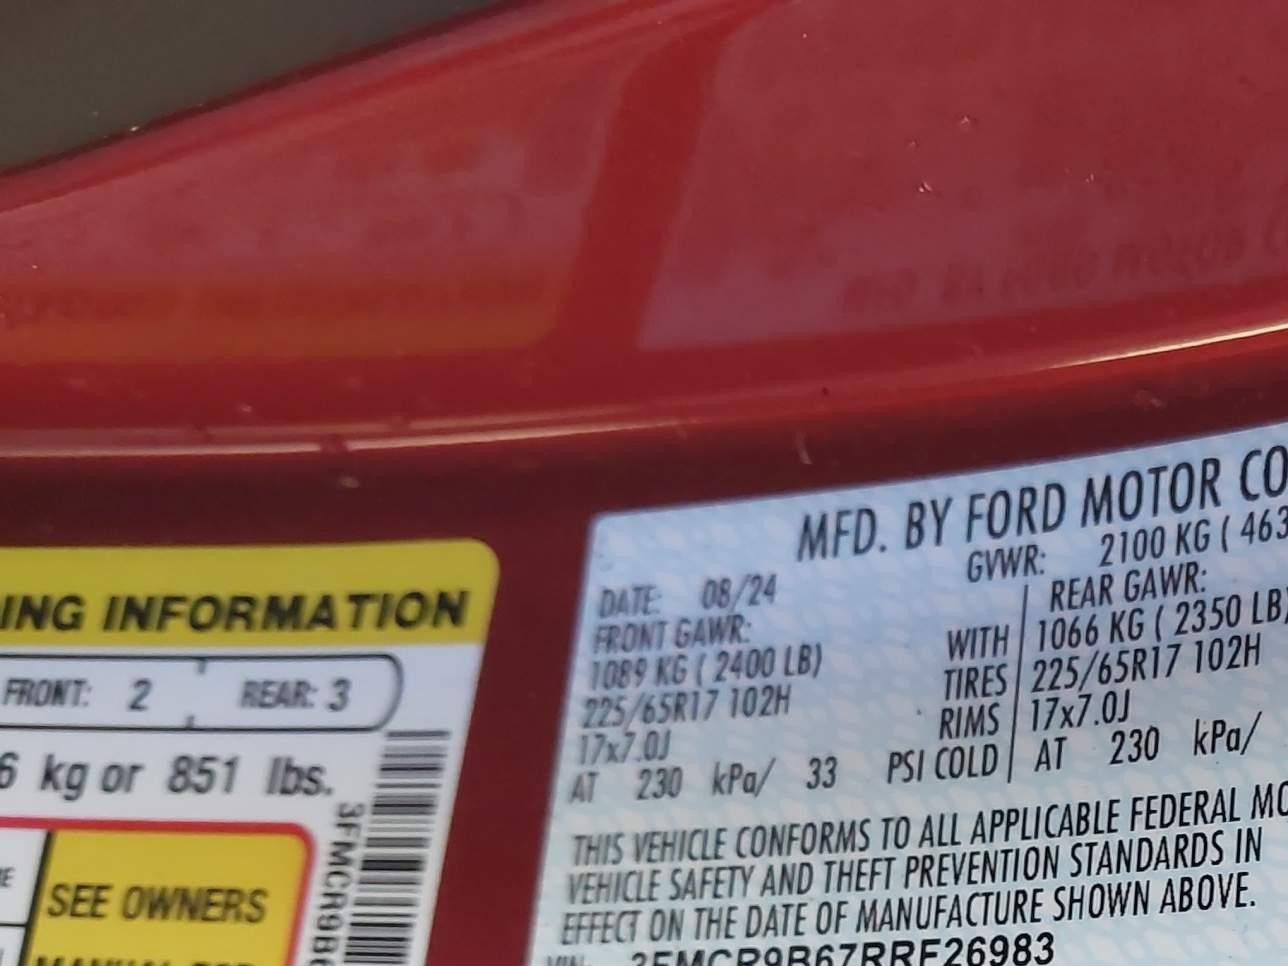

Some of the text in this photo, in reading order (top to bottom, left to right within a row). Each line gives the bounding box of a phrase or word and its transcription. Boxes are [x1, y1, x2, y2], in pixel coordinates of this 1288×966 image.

[796, 507, 888, 562] MFD.
[905, 496, 953, 550] BY
[966, 482, 1066, 542] FORD
[1080, 458, 1221, 528] MOTOR
[967, 544, 1047, 583] GVWR:
[1099, 526, 1167, 568] 2100
[1175, 517, 1211, 551] KG
[1221, 515, 1229, 553] (
[599, 574, 778, 617] DATE: 08/24
[1050, 561, 1207, 612] REAR GAWR:
[102, 590, 470, 632] INFORMATION
[1038, 609, 1100, 653] 1066
[1109, 606, 1145, 643] KG
[1155, 606, 1165, 642] (
[1174, 594, 1242, 637] 2350
[593, 616, 752, 653] FRONT GAWR:
[947, 624, 1009, 661] WITH
[590, 643, 822, 690] 1089 KG ( 2400 LB)
[944, 664, 1007, 701] TIRES
[1031, 633, 1262, 693] 225/65R17 102H
[4, 678, 153, 711] FRONT: 2
[238, 679, 352, 711] REAR: 3
[582, 684, 792, 729] 225/65R17 102H
[1031, 690, 1131, 733] 17x7.0J
[940, 702, 1000, 740] RIMS
[1034, 736, 1068, 773] AT
[1110, 725, 1160, 766] 230
[1193, 711, 1263, 756] kPa/
[578, 729, 672, 764] 17x7.0J
[40, 752, 89, 801] kg
[101, 762, 144, 794] or
[167, 756, 241, 794] 851
[264, 758, 335, 796] lbs.
[569, 741, 999, 802] AT 230 kPa/ 33 PSI COLD
[572, 832, 624, 868] THIS
[634, 826, 728, 865] VEHICLE
[735, 817, 872, 861] CONFORMS
[881, 814, 911, 851] TO
[918, 813, 962, 849] ALL
[970, 800, 1121, 843] APPLICABLE
[1130, 787, 1242, 833] FEDERAL
[567, 826, 1263, 905] VEHICLE SAFETY AND THEFT PREVENTION STANDARDS IN
[46, 883, 269, 924] SEE OWNERS
[561, 872, 1257, 945] EFFECT ON THE DATE OF MANUFACTURE SHOWN ABOVE.
